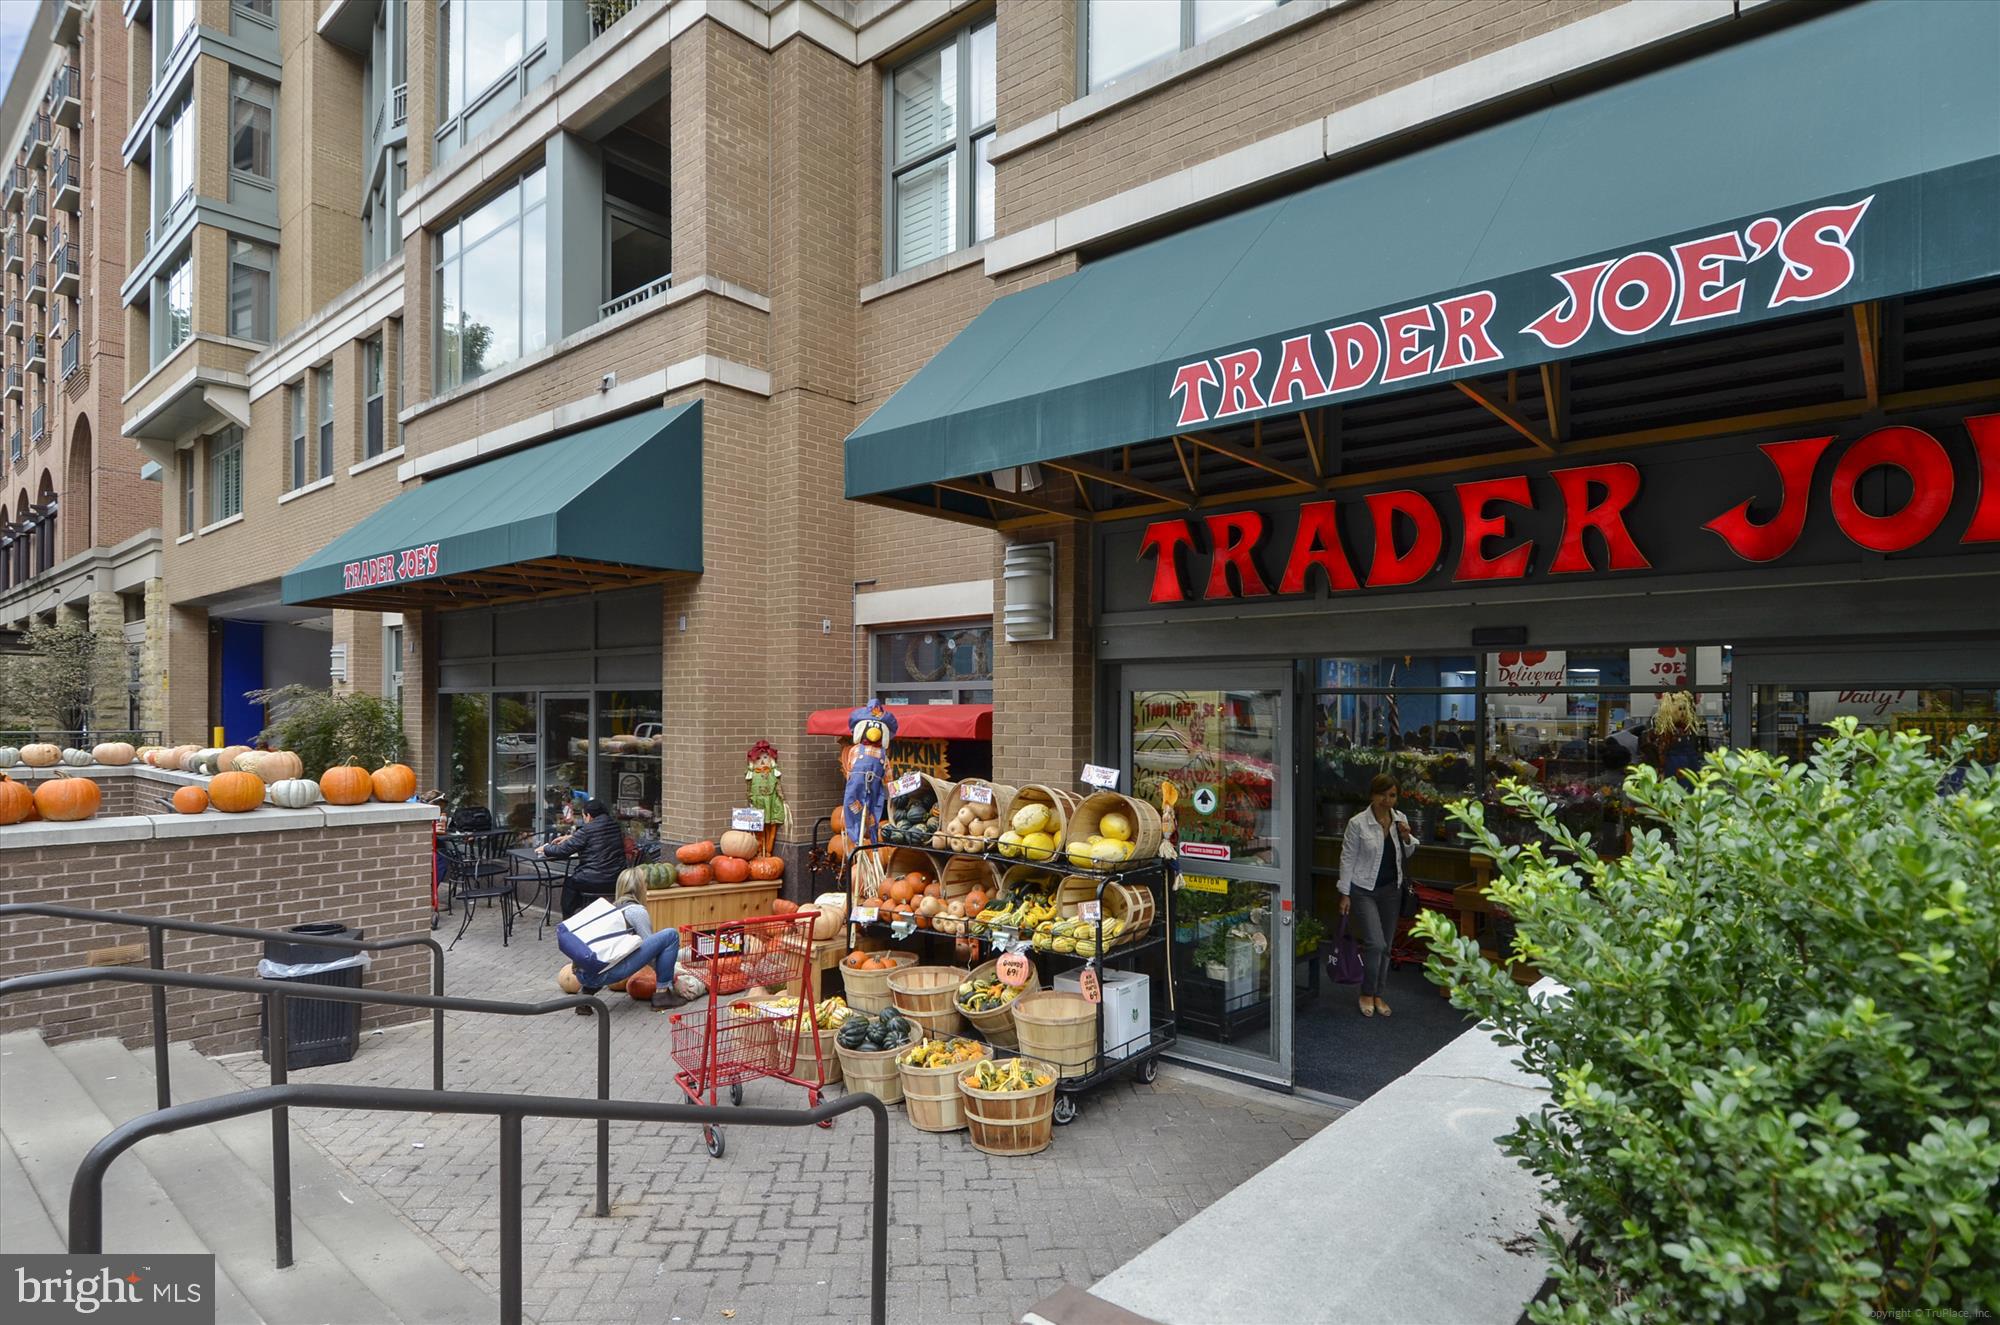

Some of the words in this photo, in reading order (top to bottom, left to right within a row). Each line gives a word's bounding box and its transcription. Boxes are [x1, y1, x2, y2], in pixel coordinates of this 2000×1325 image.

[1169, 289, 1505, 428] TRADER
[1519, 194, 1876, 350] JOE'S
[1135, 462, 1652, 604] TRADER
[343, 554, 396, 590] TRADER
[396, 542, 440, 580] JOE'S
[1498, 664, 1566, 683] Delivered
[1649, 661, 1687, 675] JOE'
[1189, 876, 1220, 885] CAUTION
